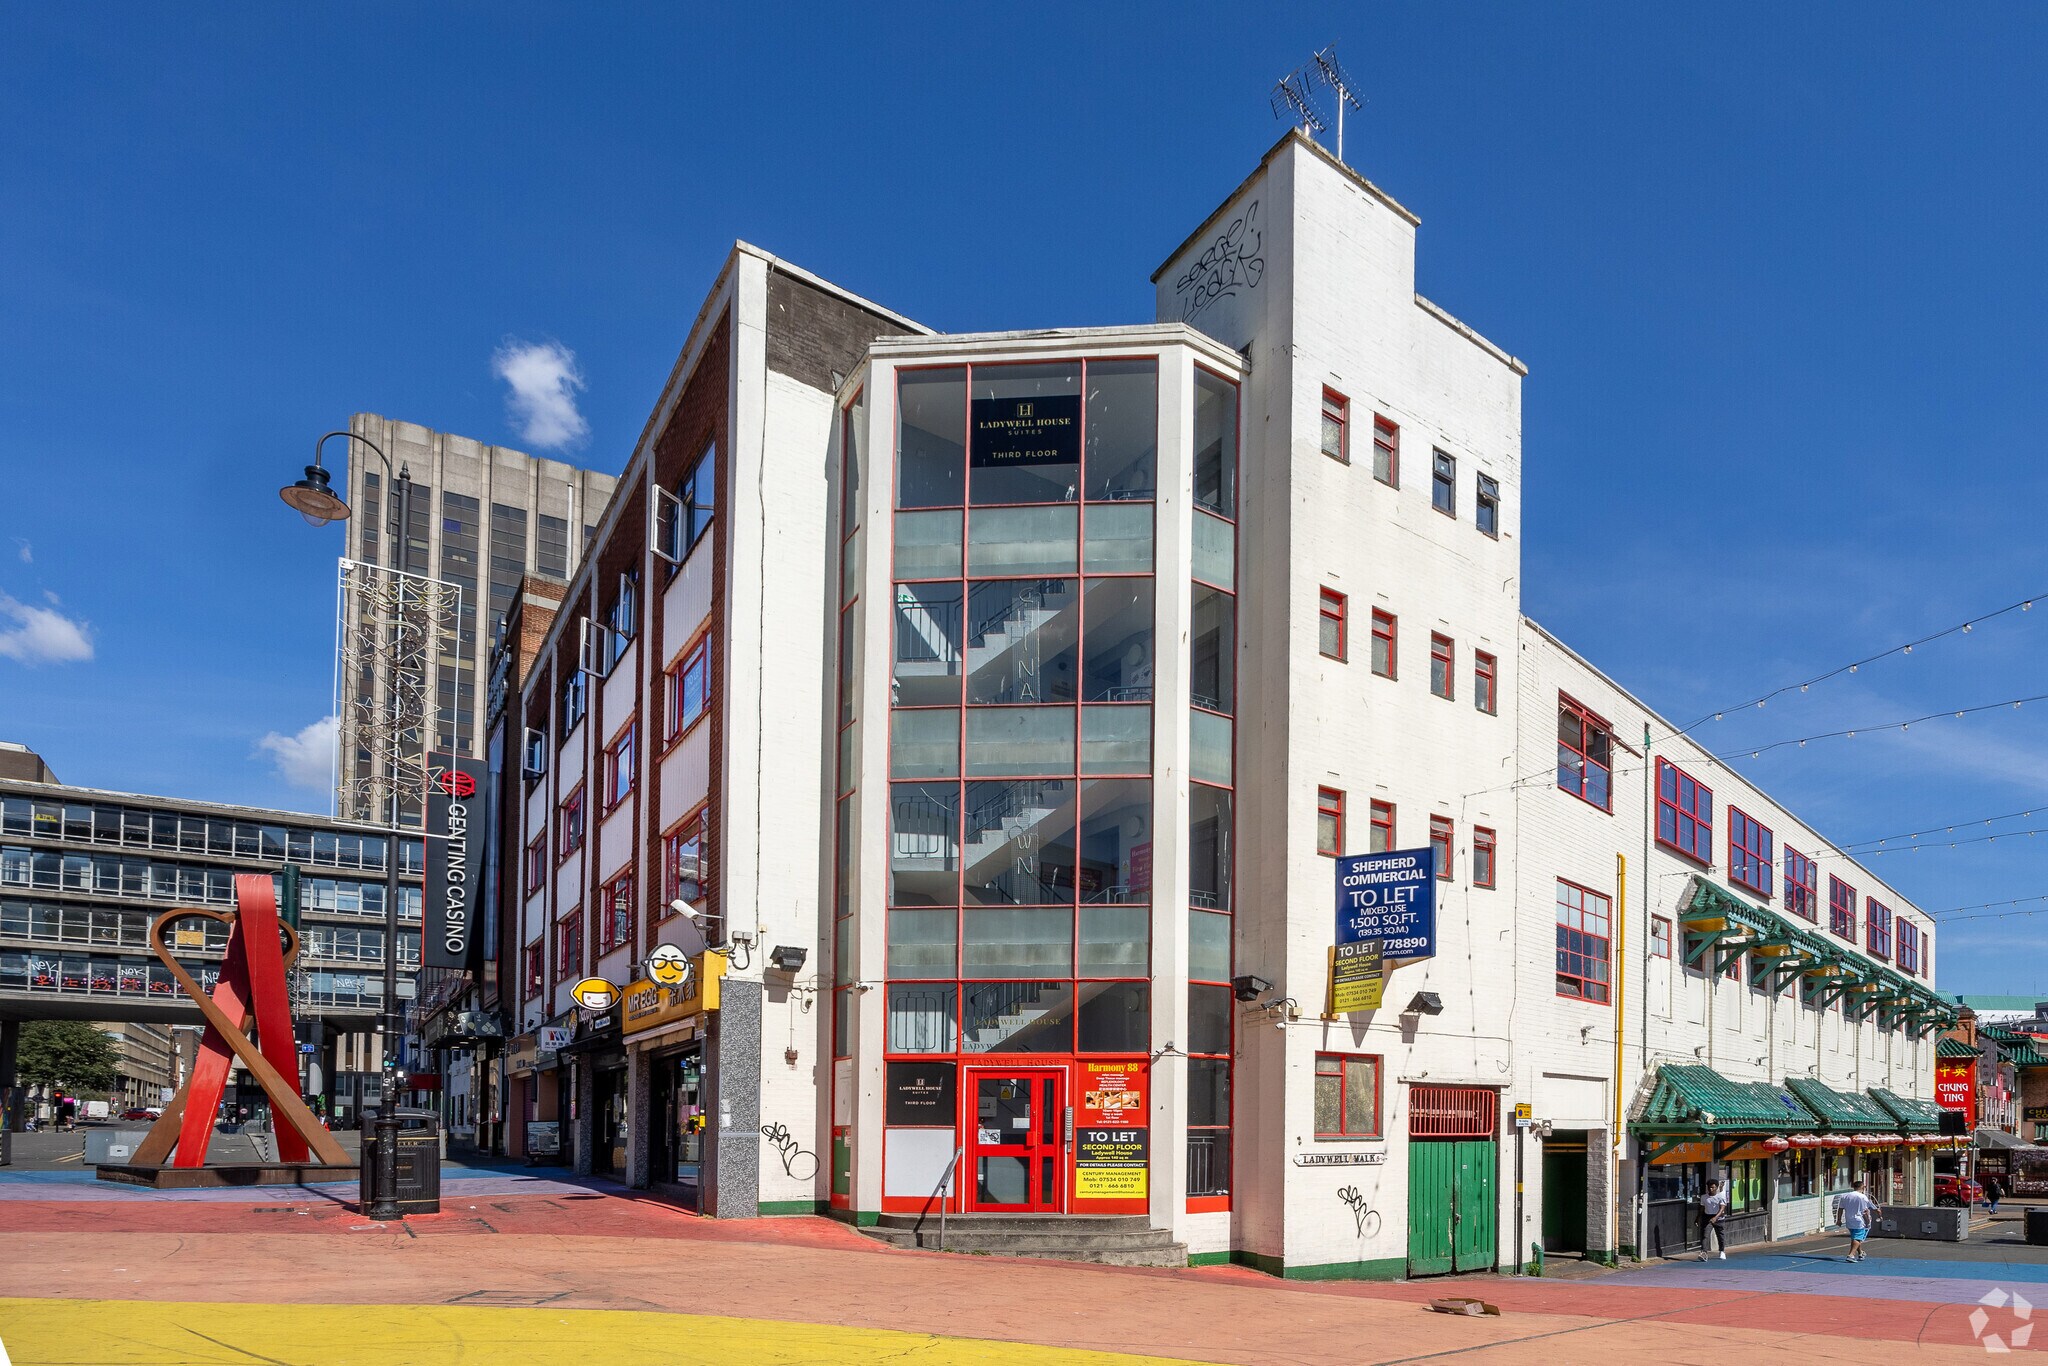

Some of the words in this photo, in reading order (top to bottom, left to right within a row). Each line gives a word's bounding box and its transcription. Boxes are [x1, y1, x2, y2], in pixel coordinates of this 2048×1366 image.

[980, 420, 1034, 429] LADYWELL
[1037, 418, 1071, 426] HOUSE
[992, 451, 1021, 459] THIRD
[1025, 450, 1058, 458] FLOOR
[447, 803, 467, 884] GENTING
[1352, 857, 1416, 873] SHEPHERD
[1342, 869, 1426, 887] COMMERCIAL
[1349, 889, 1377, 907] TO
[1384, 885, 1419, 904] LET
[1360, 905, 1388, 916] MIXED
[1390, 904, 1407, 913] USE
[445, 886, 466, 953] CASINO
[1349, 916, 1379, 929] 1,500
[1382, 913, 1419, 926] SQ.FT.
[1339, 946, 1354, 957] TO
[1356, 942, 1375, 955] LET
[1382, 937, 1427, 950] 778890
[1335, 957, 1358, 967] SECOND
[1359, 953, 1379, 963] FLOOR
[627, 992, 640, 1013] MR
[640, 986, 658, 1008] EGG
[1087, 1063, 1126, 1073] Harmony
[1127, 1062, 1139, 1072] 88
[1939, 1063, 1968, 1078] 中英
[1938, 1083, 1969, 1092] CHUNG
[1943, 1093, 1964, 1102] YING
[1088, 1131, 1108, 1142] TO
[1112, 1132, 1137, 1142] LET
[1303, 1155, 1349, 1164] LADYWELL
[1353, 1154, 1376, 1163] WALK
